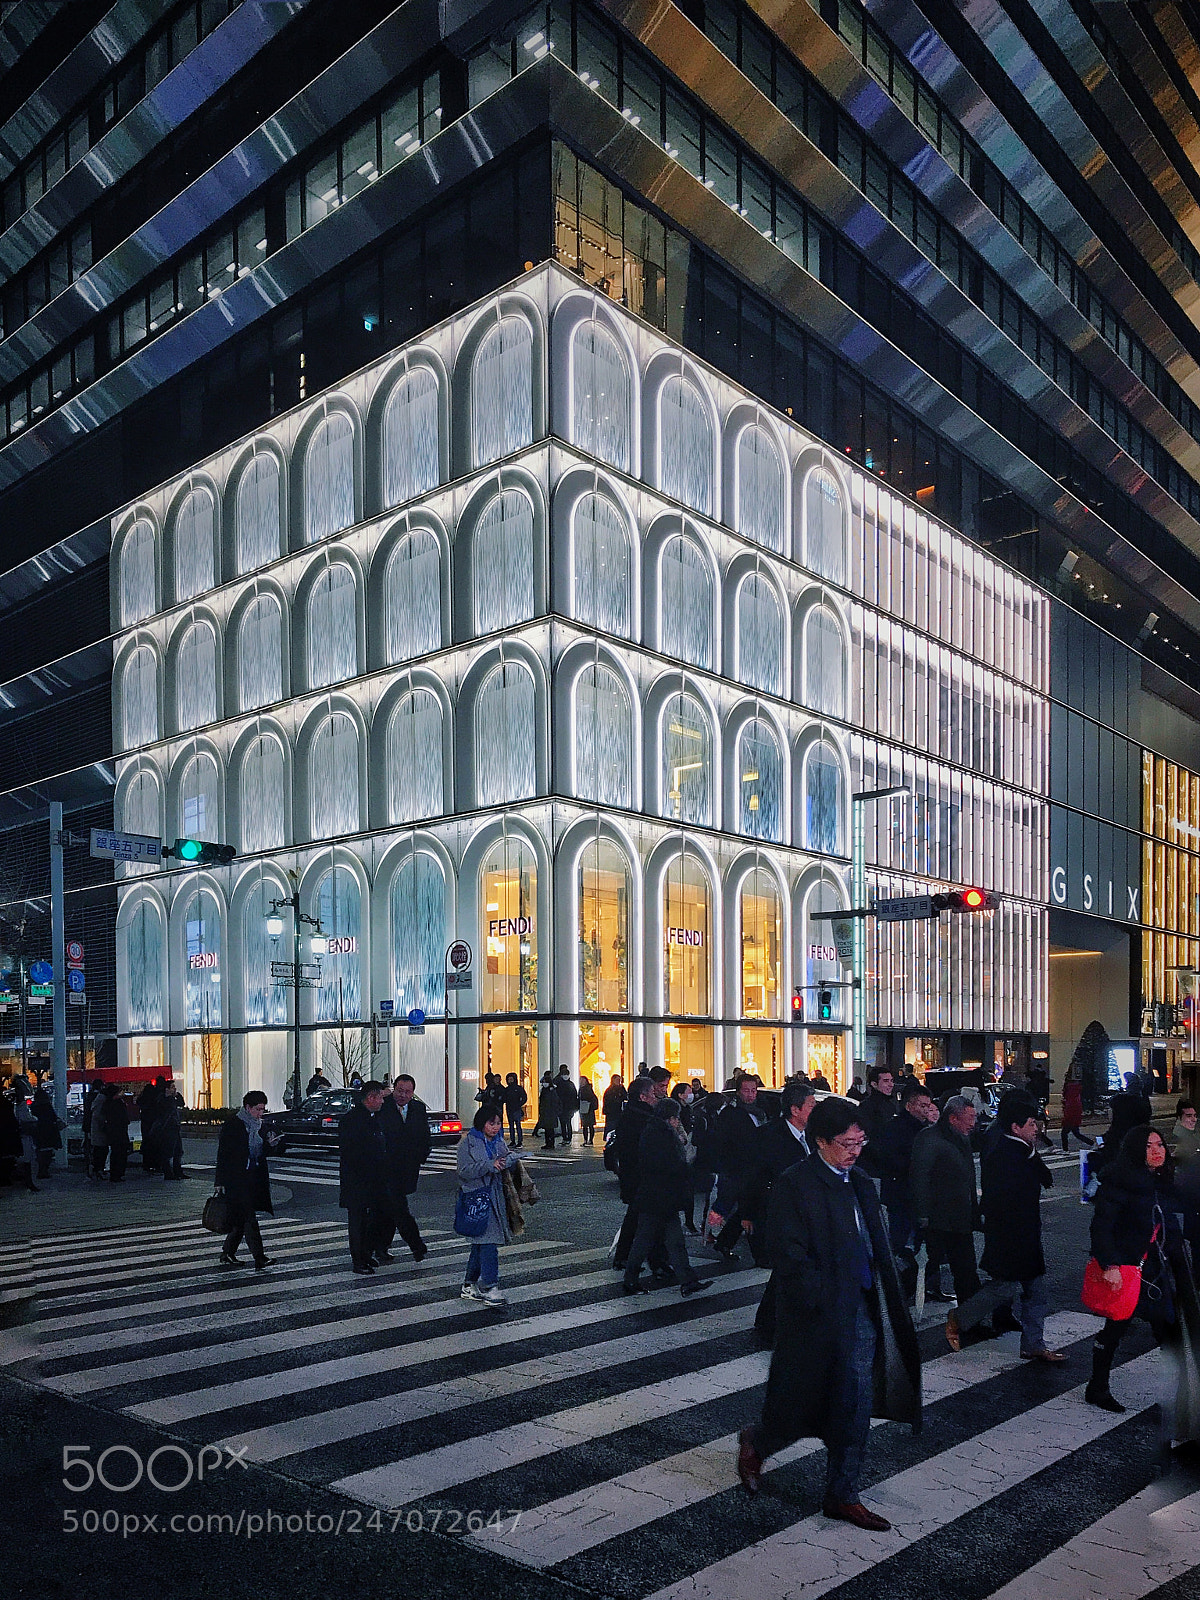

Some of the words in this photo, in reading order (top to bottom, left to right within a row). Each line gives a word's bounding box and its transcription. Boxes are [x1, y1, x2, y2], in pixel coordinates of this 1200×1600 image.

[96, 837, 157, 856] 銀座五丁目
[489, 916, 534, 938] FENDI
[668, 927, 704, 947] FENDI
[190, 952, 218, 970] FENDI
[810, 945, 838, 961] FENDI
